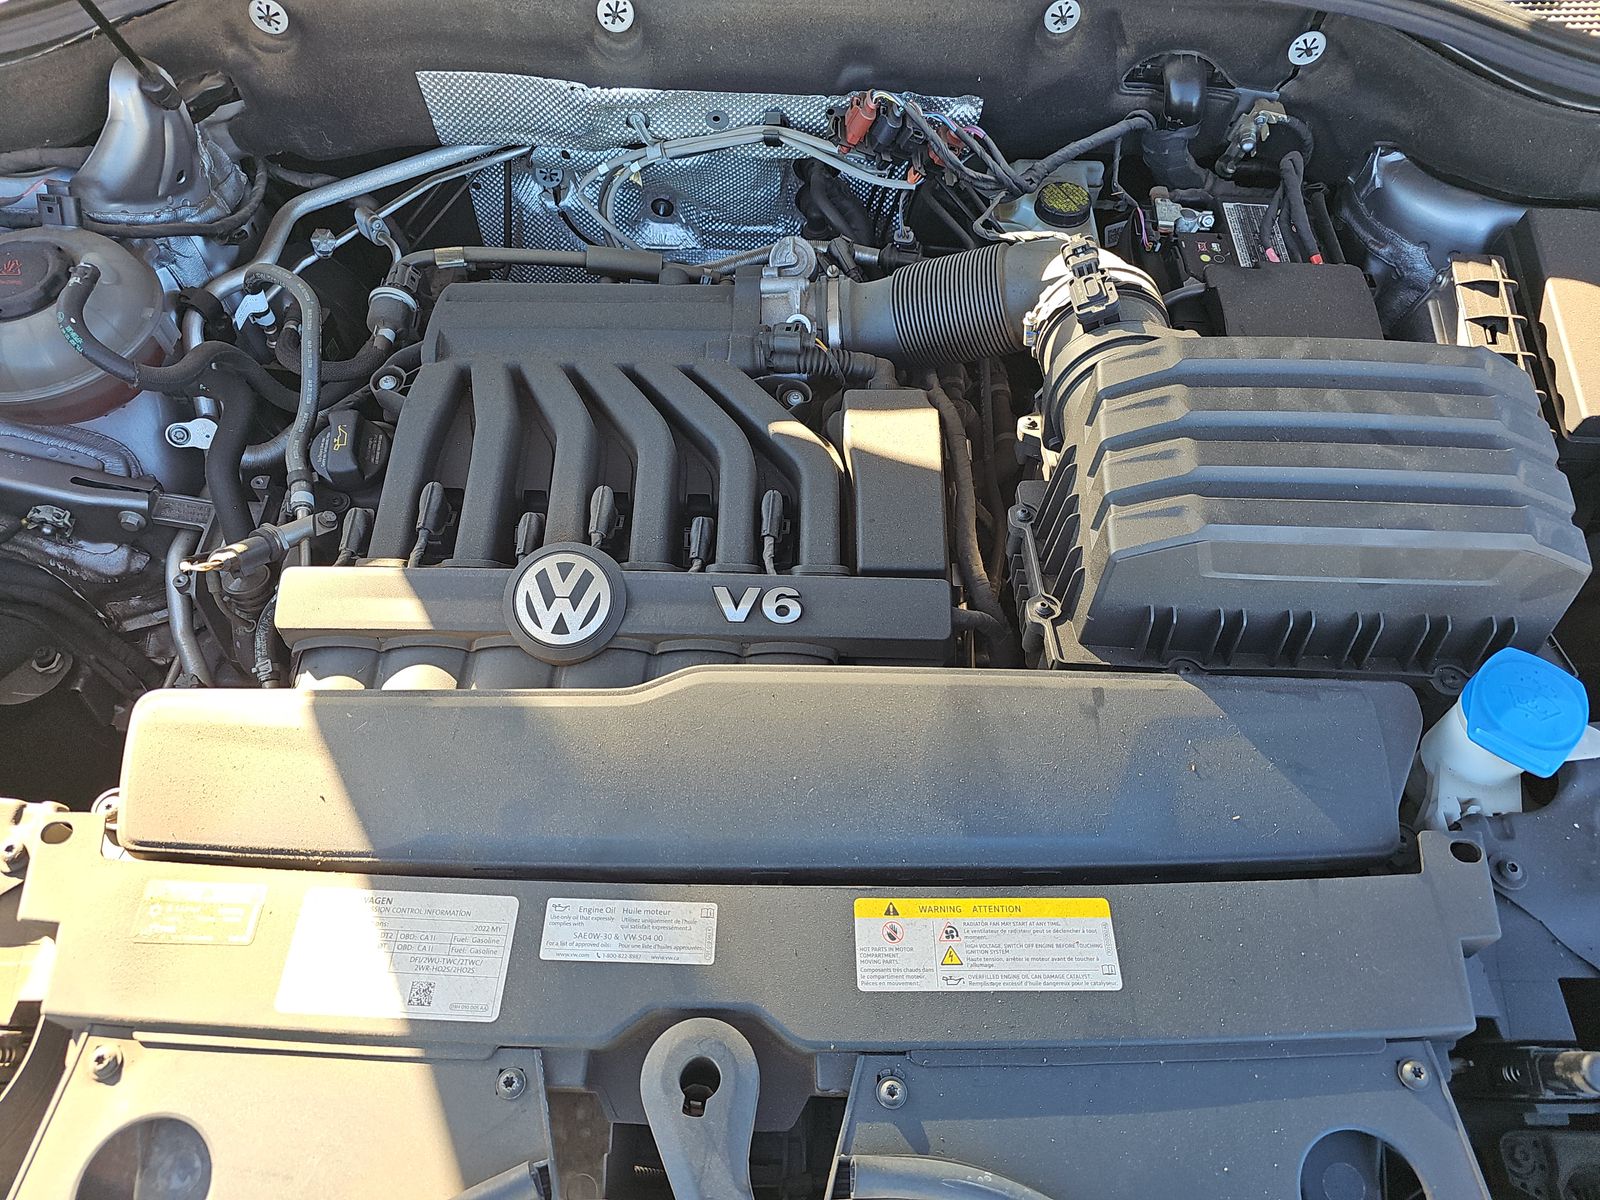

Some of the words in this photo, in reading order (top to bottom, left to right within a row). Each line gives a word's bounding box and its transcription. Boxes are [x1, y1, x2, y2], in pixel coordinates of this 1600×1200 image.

[516, 554, 611, 645] VW
[712, 586, 802, 624] V6
[392, 907, 423, 915] CONTROL
[424, 908, 472, 917] INFORMATION
[579, 906, 604, 915] Engine
[622, 907, 642, 915] Huile
[918, 905, 962, 913] WARNING
[972, 905, 1022, 913] ATTENTION
[400, 933, 418, 941] OBD:
[471, 937, 500, 945] Gasoline
[573, 932, 613, 940] SAE0W-30
[654, 934, 664, 942] 00
[469, 948, 498, 956] Gasoline
